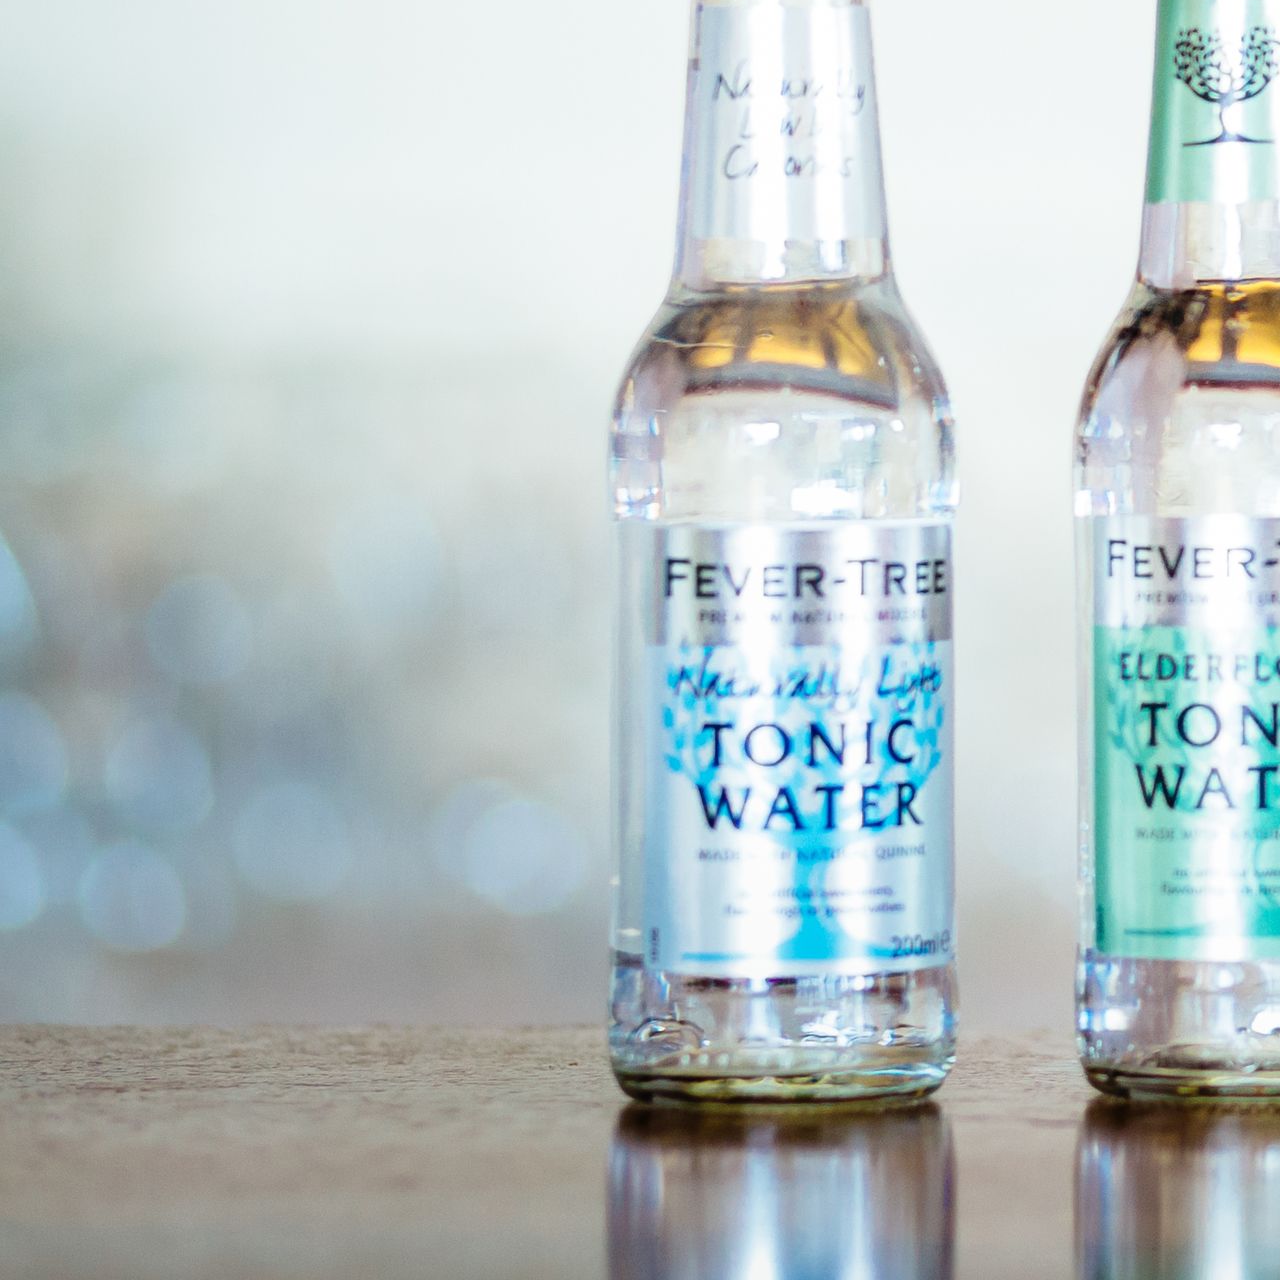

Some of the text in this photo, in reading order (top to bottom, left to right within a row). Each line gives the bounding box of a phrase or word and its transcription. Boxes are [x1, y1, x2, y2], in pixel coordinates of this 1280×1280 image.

[664, 559, 948, 600] FEVER-TREE
[701, 721, 917, 769] TONIC
[695, 783, 924, 832] WATER
